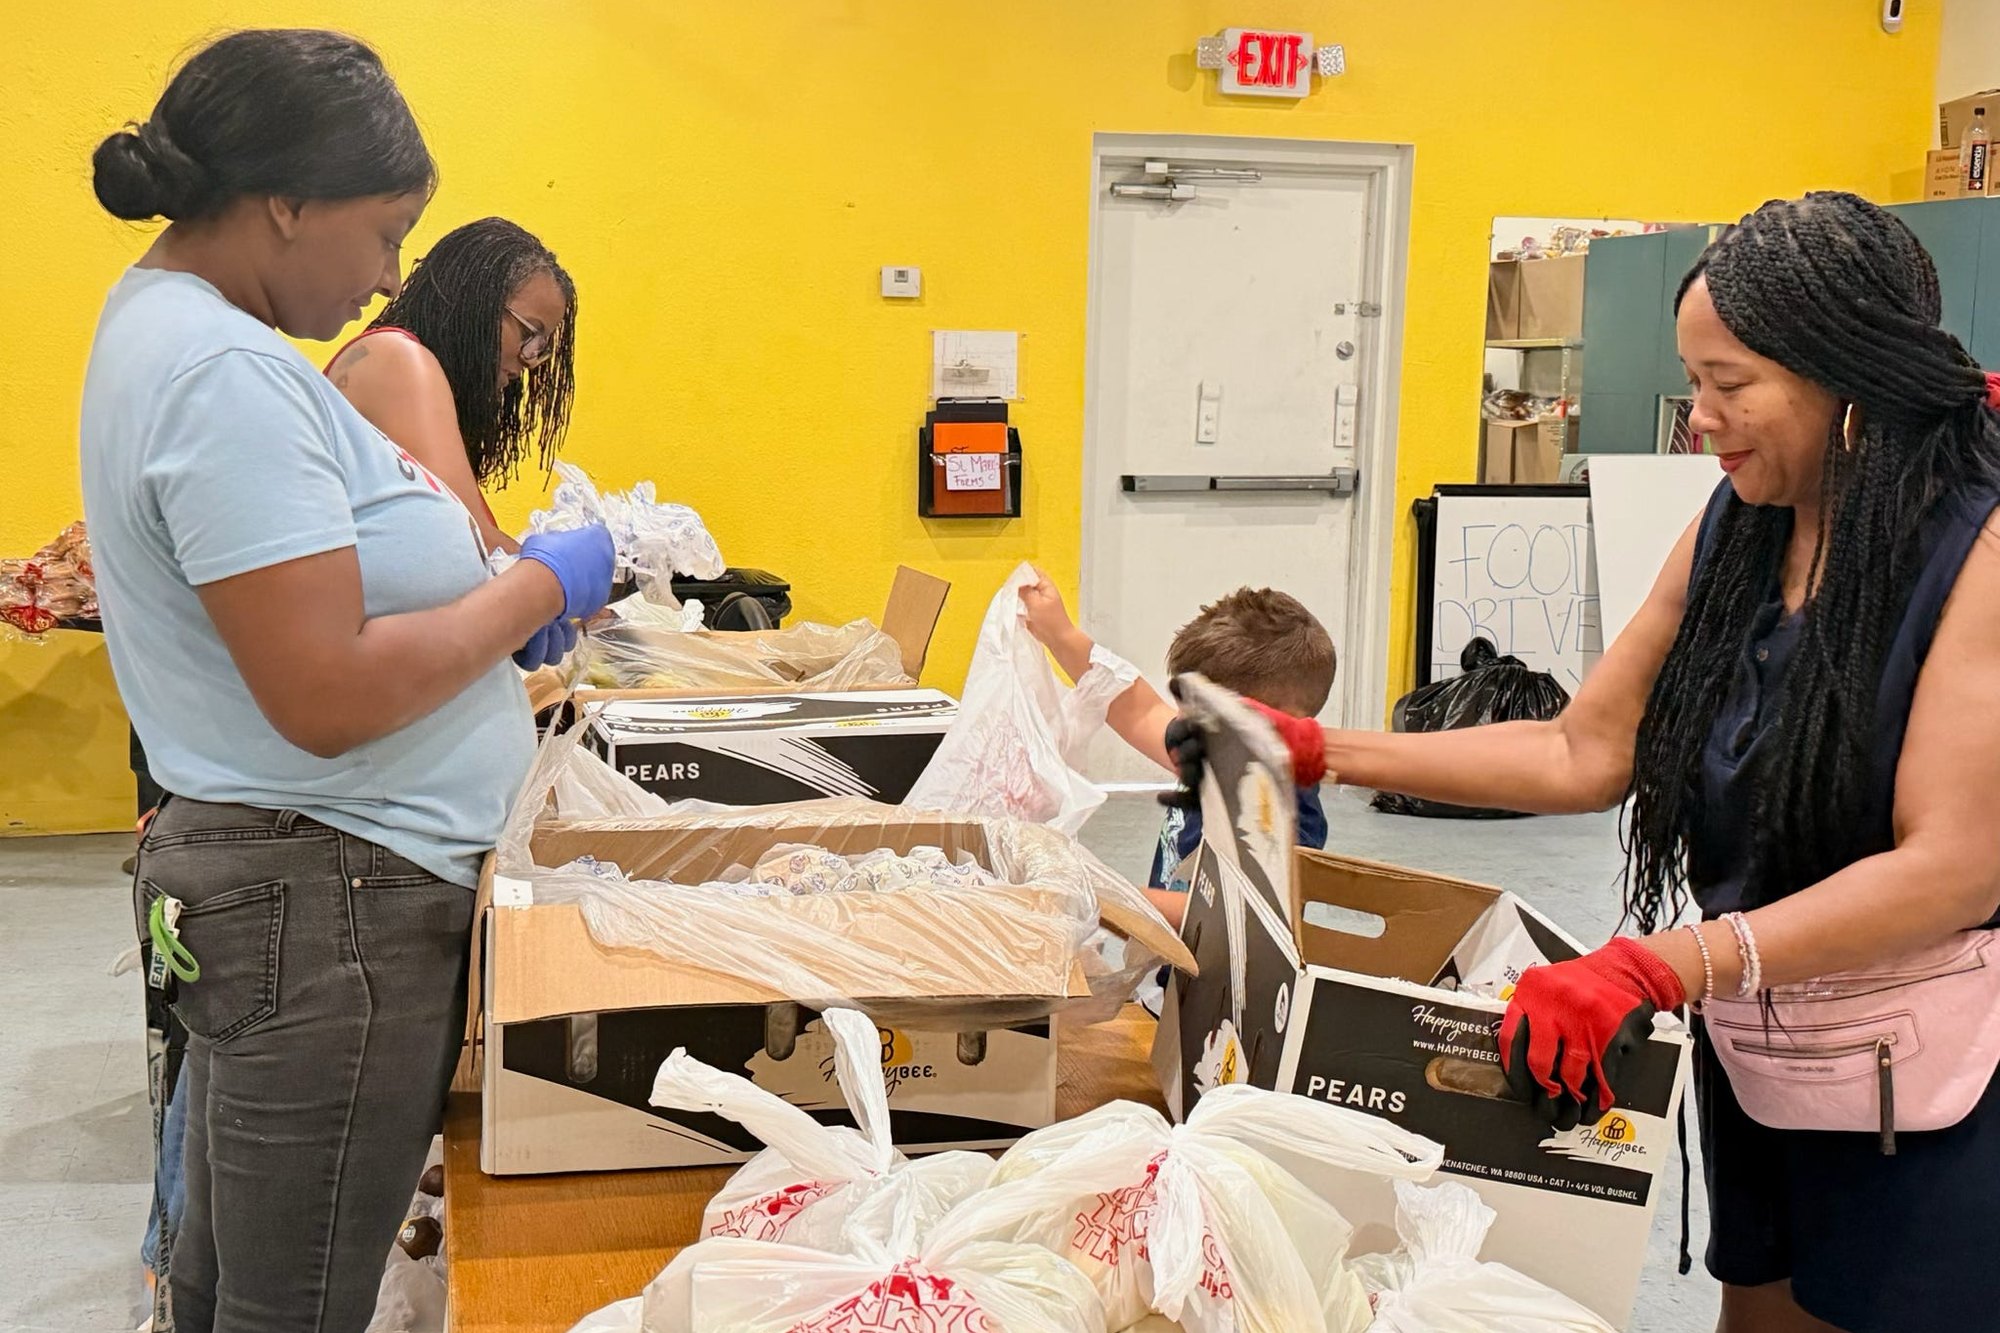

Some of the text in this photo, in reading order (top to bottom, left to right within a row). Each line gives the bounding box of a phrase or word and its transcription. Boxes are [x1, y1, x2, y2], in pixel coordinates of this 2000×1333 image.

[1237, 32, 1303, 88] EXIT
[1436, 598, 1604, 655] DRIVE
[625, 762, 700, 781] PEARS
[1306, 1074, 1407, 1114] PEARS
[1490, 1167, 1502, 1176] WA
[1527, 1174, 1543, 1184] USA
[1549, 1177, 1565, 1187] CAT
[1591, 1184, 1606, 1195] VOL
[1607, 1187, 1637, 1200] BUSHEL
